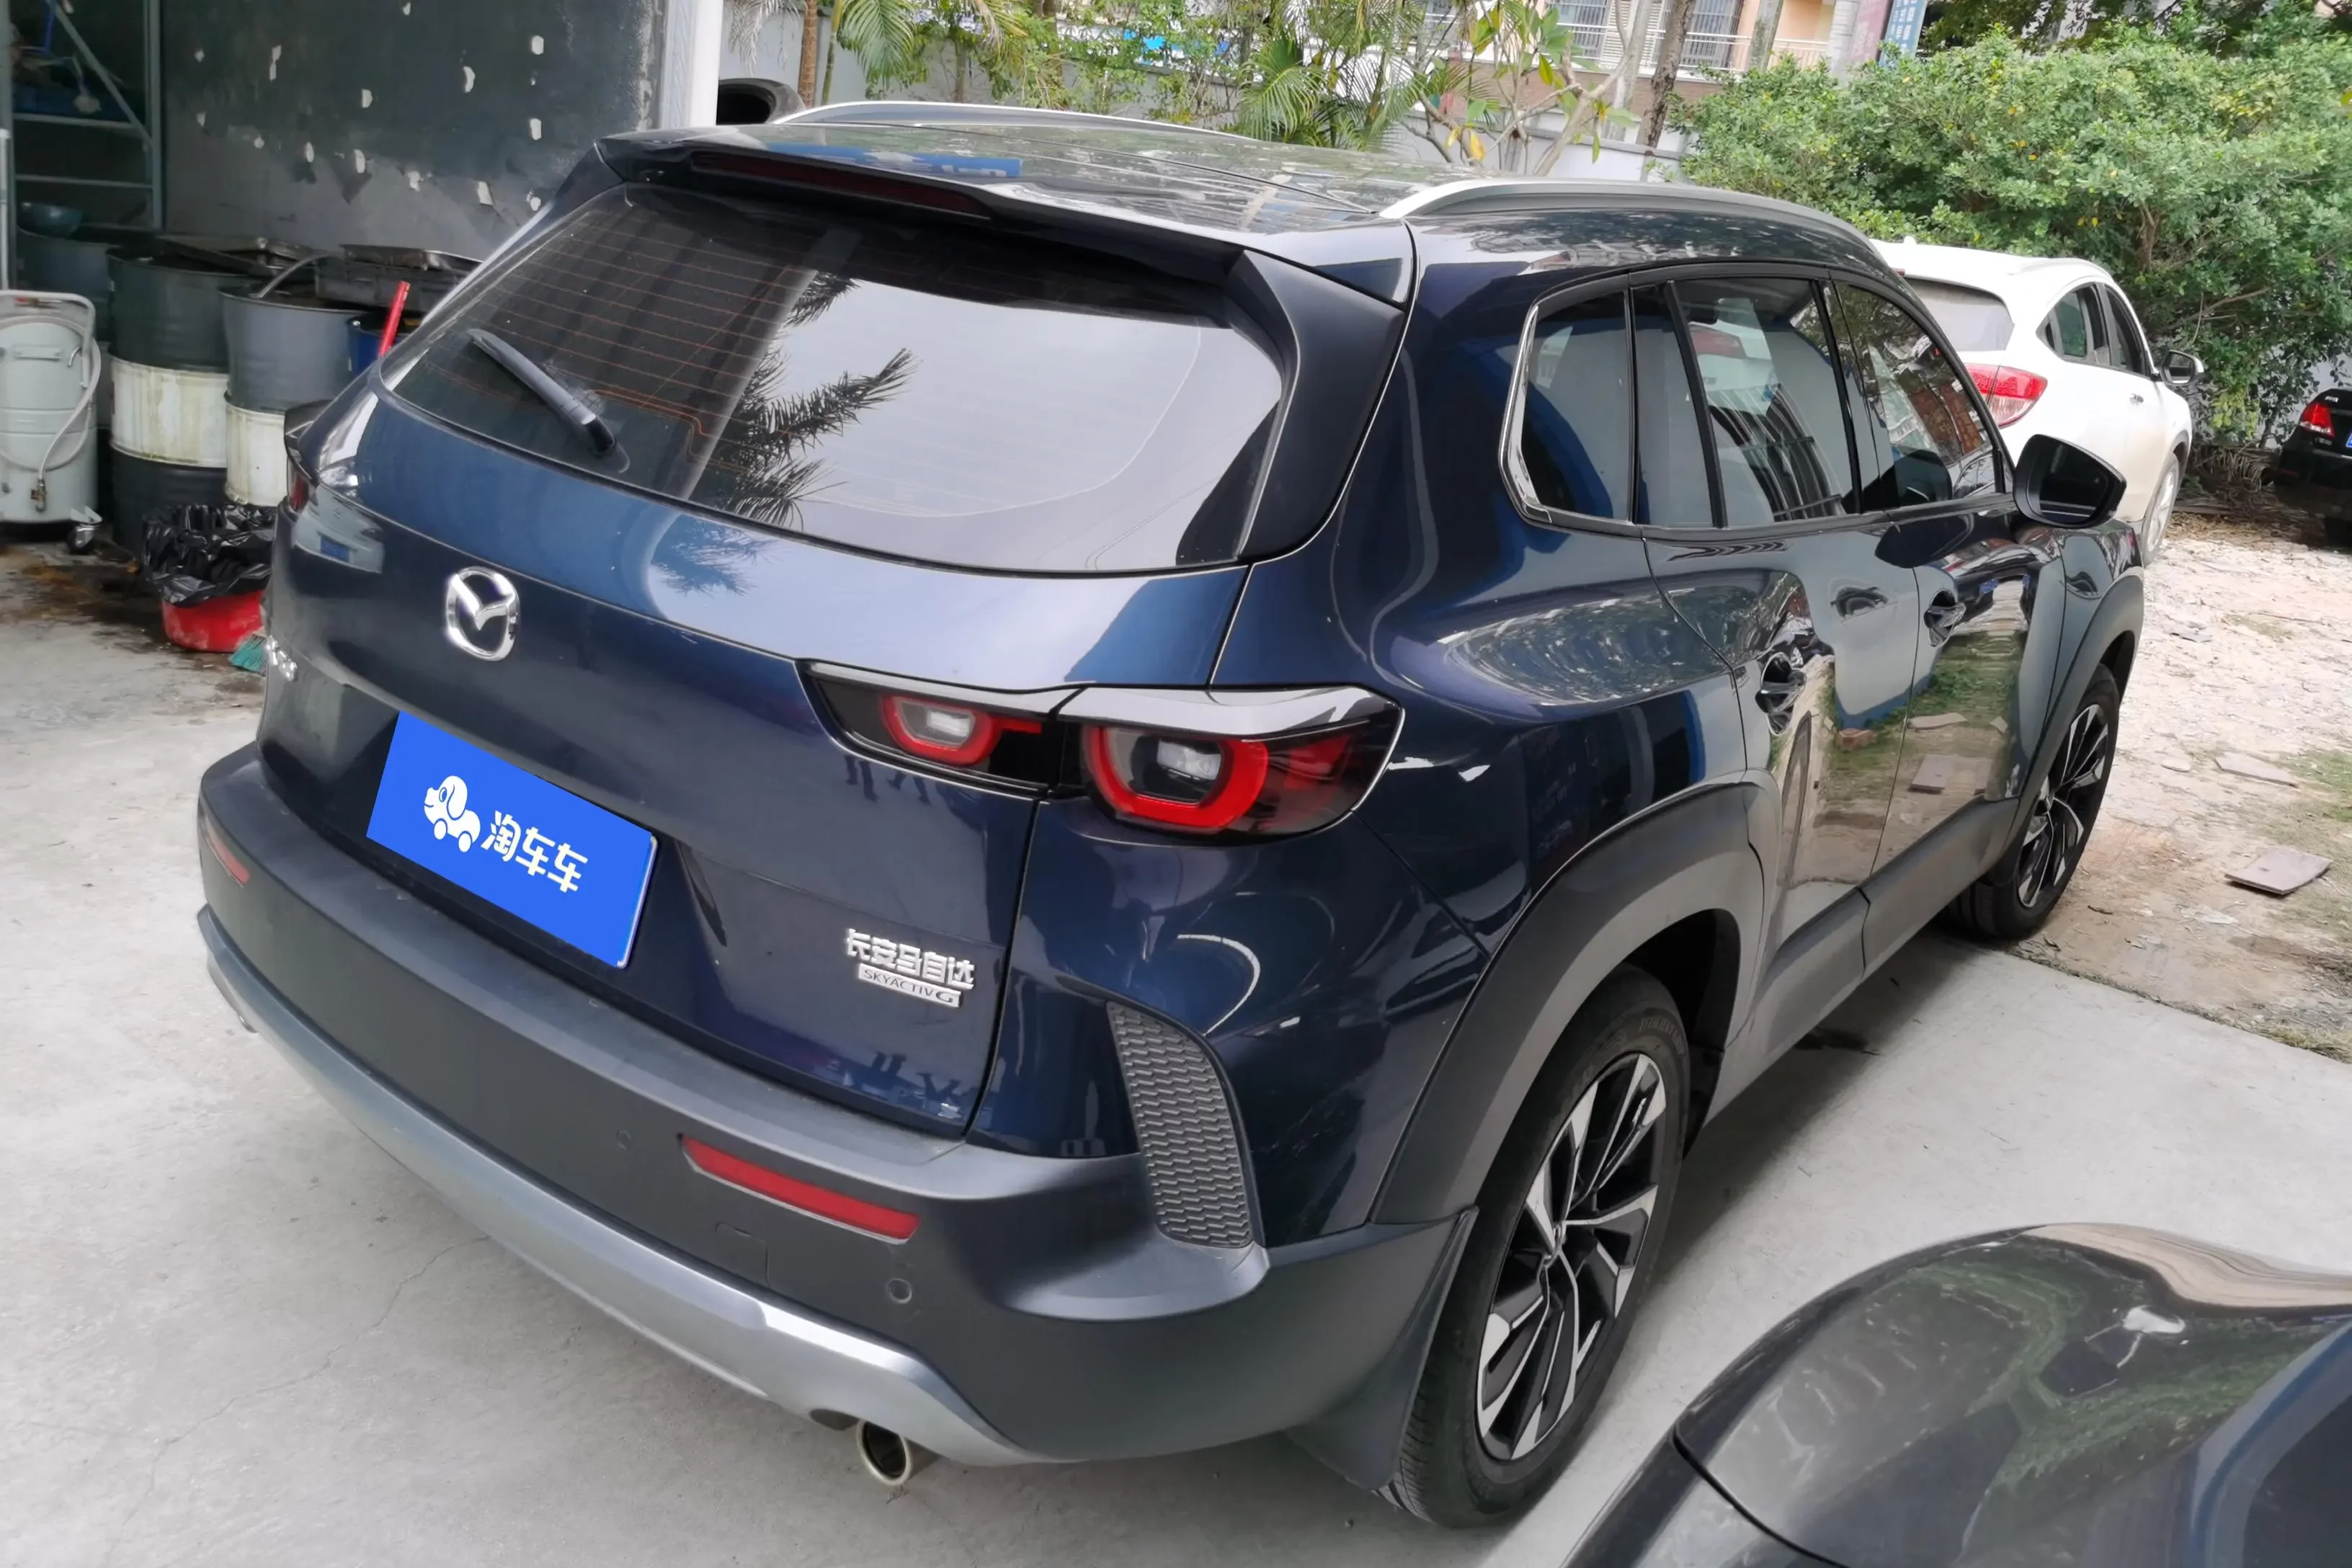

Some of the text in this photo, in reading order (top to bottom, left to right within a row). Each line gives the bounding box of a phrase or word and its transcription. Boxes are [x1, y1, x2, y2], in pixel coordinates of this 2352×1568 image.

[847, 928, 974, 989] 长安马自达
